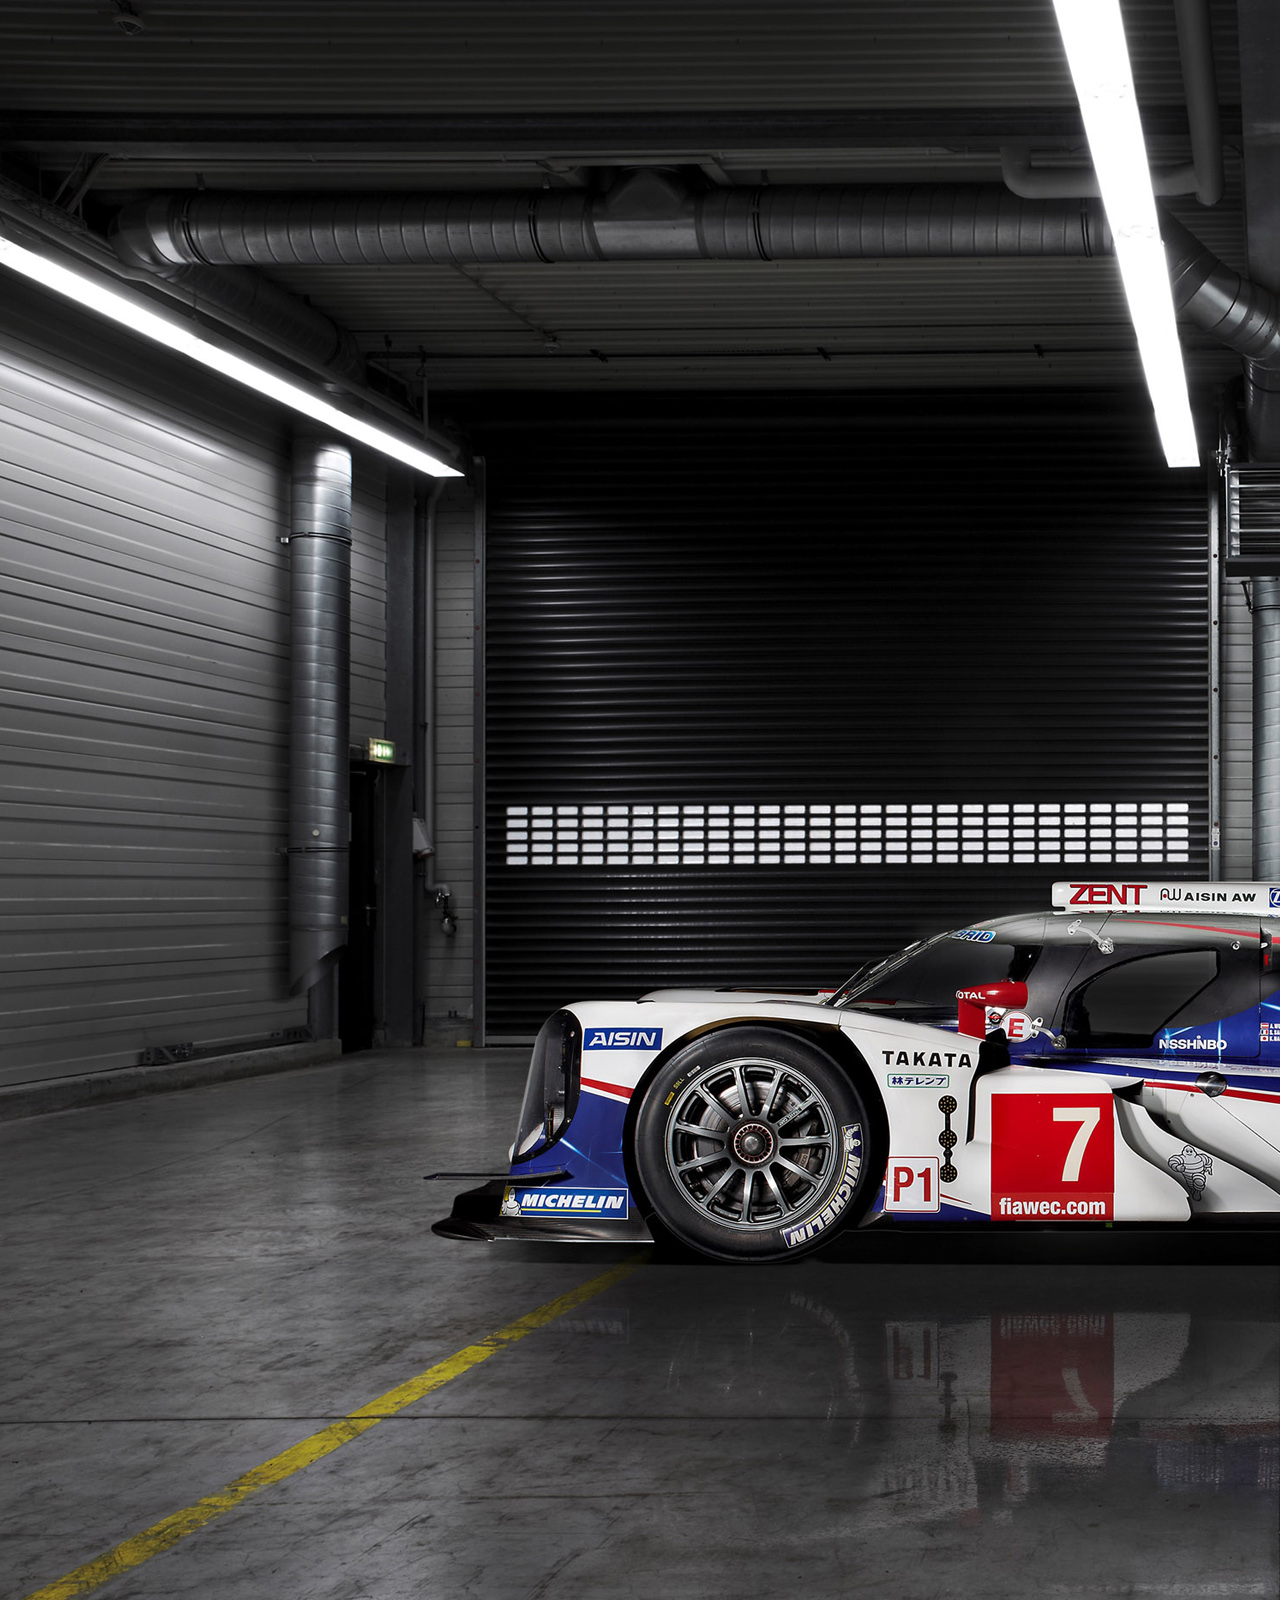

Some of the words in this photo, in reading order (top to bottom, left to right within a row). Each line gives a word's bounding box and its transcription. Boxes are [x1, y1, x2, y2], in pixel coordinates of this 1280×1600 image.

[1069, 884, 1148, 905] ZENT
[1184, 892, 1227, 902] AISIN
[1231, 893, 1256, 902] AW
[956, 990, 986, 1000] OTAL
[1008, 1018, 1025, 1038] E
[588, 1031, 657, 1047] AISIN
[882, 1050, 972, 1068] TAKATA
[892, 1076, 947, 1086] 林テレンプ
[1052, 1107, 1101, 1182] 7
[893, 1166, 932, 1203] P1
[521, 1193, 625, 1210] MICHELIN
[790, 1153, 861, 1246] MICHELIN
[999, 1198, 1106, 1216] fiawec.com
